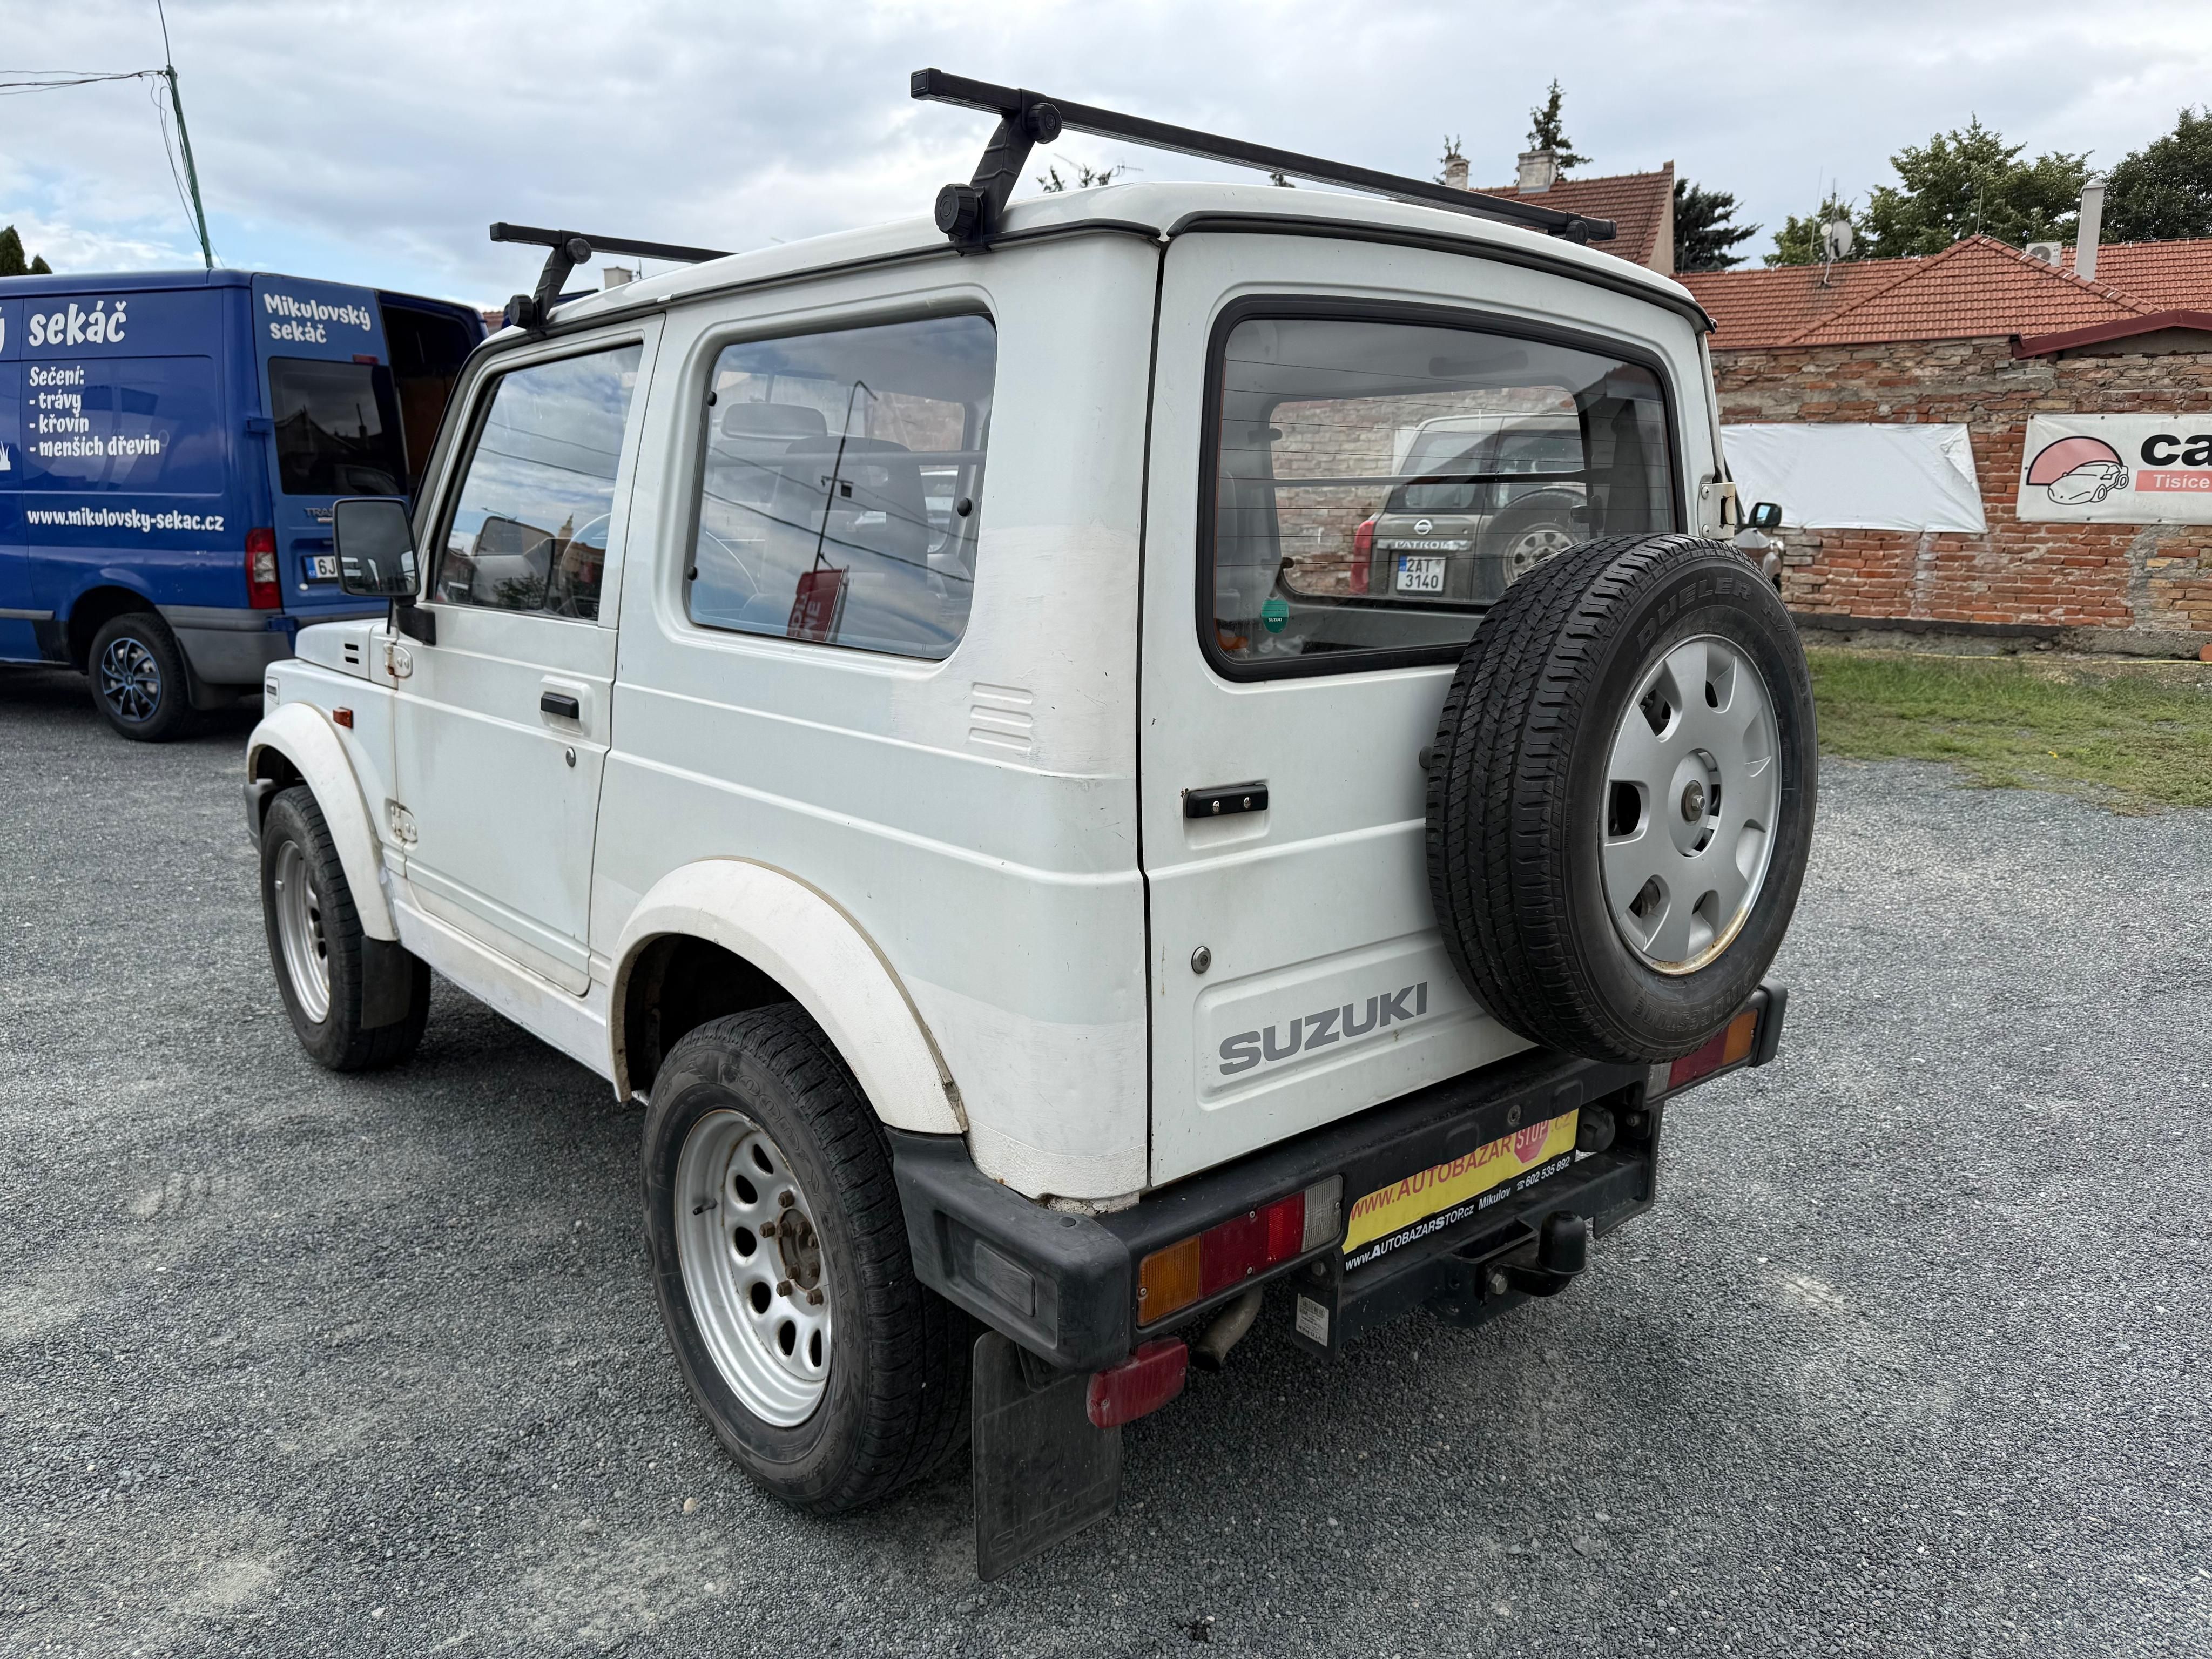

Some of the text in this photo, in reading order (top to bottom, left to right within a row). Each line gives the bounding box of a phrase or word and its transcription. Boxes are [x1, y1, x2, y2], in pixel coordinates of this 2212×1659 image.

[29, 300, 127, 346] sekáč
[264, 293, 372, 331] Mikulovský
[269, 320, 327, 343] sekáč
[29, 365, 84, 387] Sečení:
[39, 389, 82, 414] trávy
[39, 414, 89, 434] křovin
[39, 436, 103, 457] menších
[107, 434, 160, 456] dřevin
[2153, 473, 2210, 489] Tisíce
[28, 507, 224, 532] www.mikulovsky-sekac.cz
[1406, 558, 1431, 572] 2AT
[1405, 574, 1439, 589] 3140
[1637, 577, 1754, 653] DUELER
[1219, 981, 1428, 1075] SUZUKI
[1478, 1187, 1511, 1210] Mikulov
[1525, 1171, 1540, 1187] 602
[1541, 1163, 1555, 1179] 535
[1556, 1156, 1570, 1171] 892
